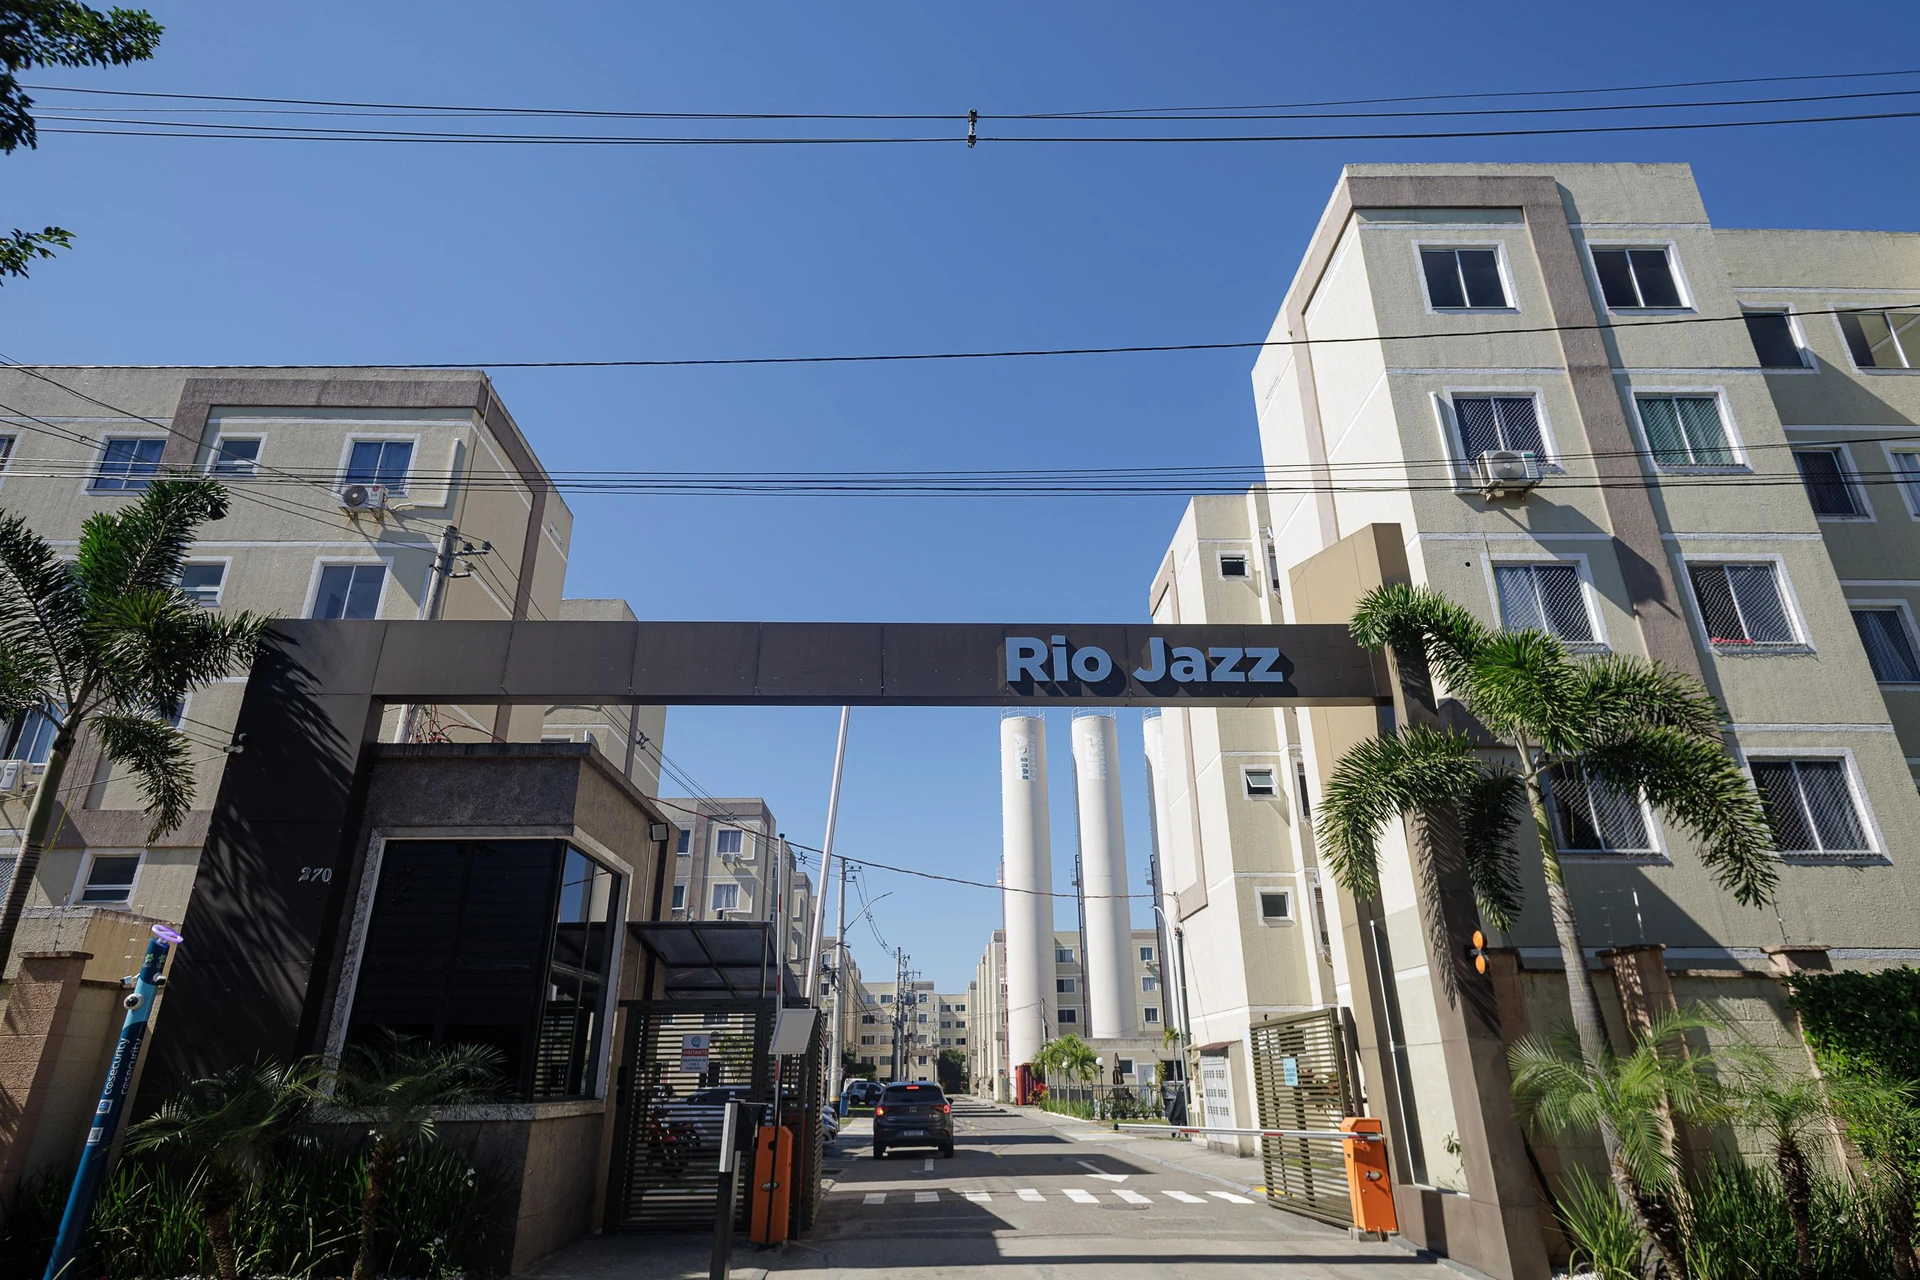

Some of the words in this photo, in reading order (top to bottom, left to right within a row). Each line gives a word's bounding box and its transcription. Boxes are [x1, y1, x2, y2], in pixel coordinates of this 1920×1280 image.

[1005, 635, 1112, 683] Rio
[1132, 636, 1283, 683] Jazz
[298, 866, 333, 883] 270
[104, 1037, 130, 1095] cosecurity
